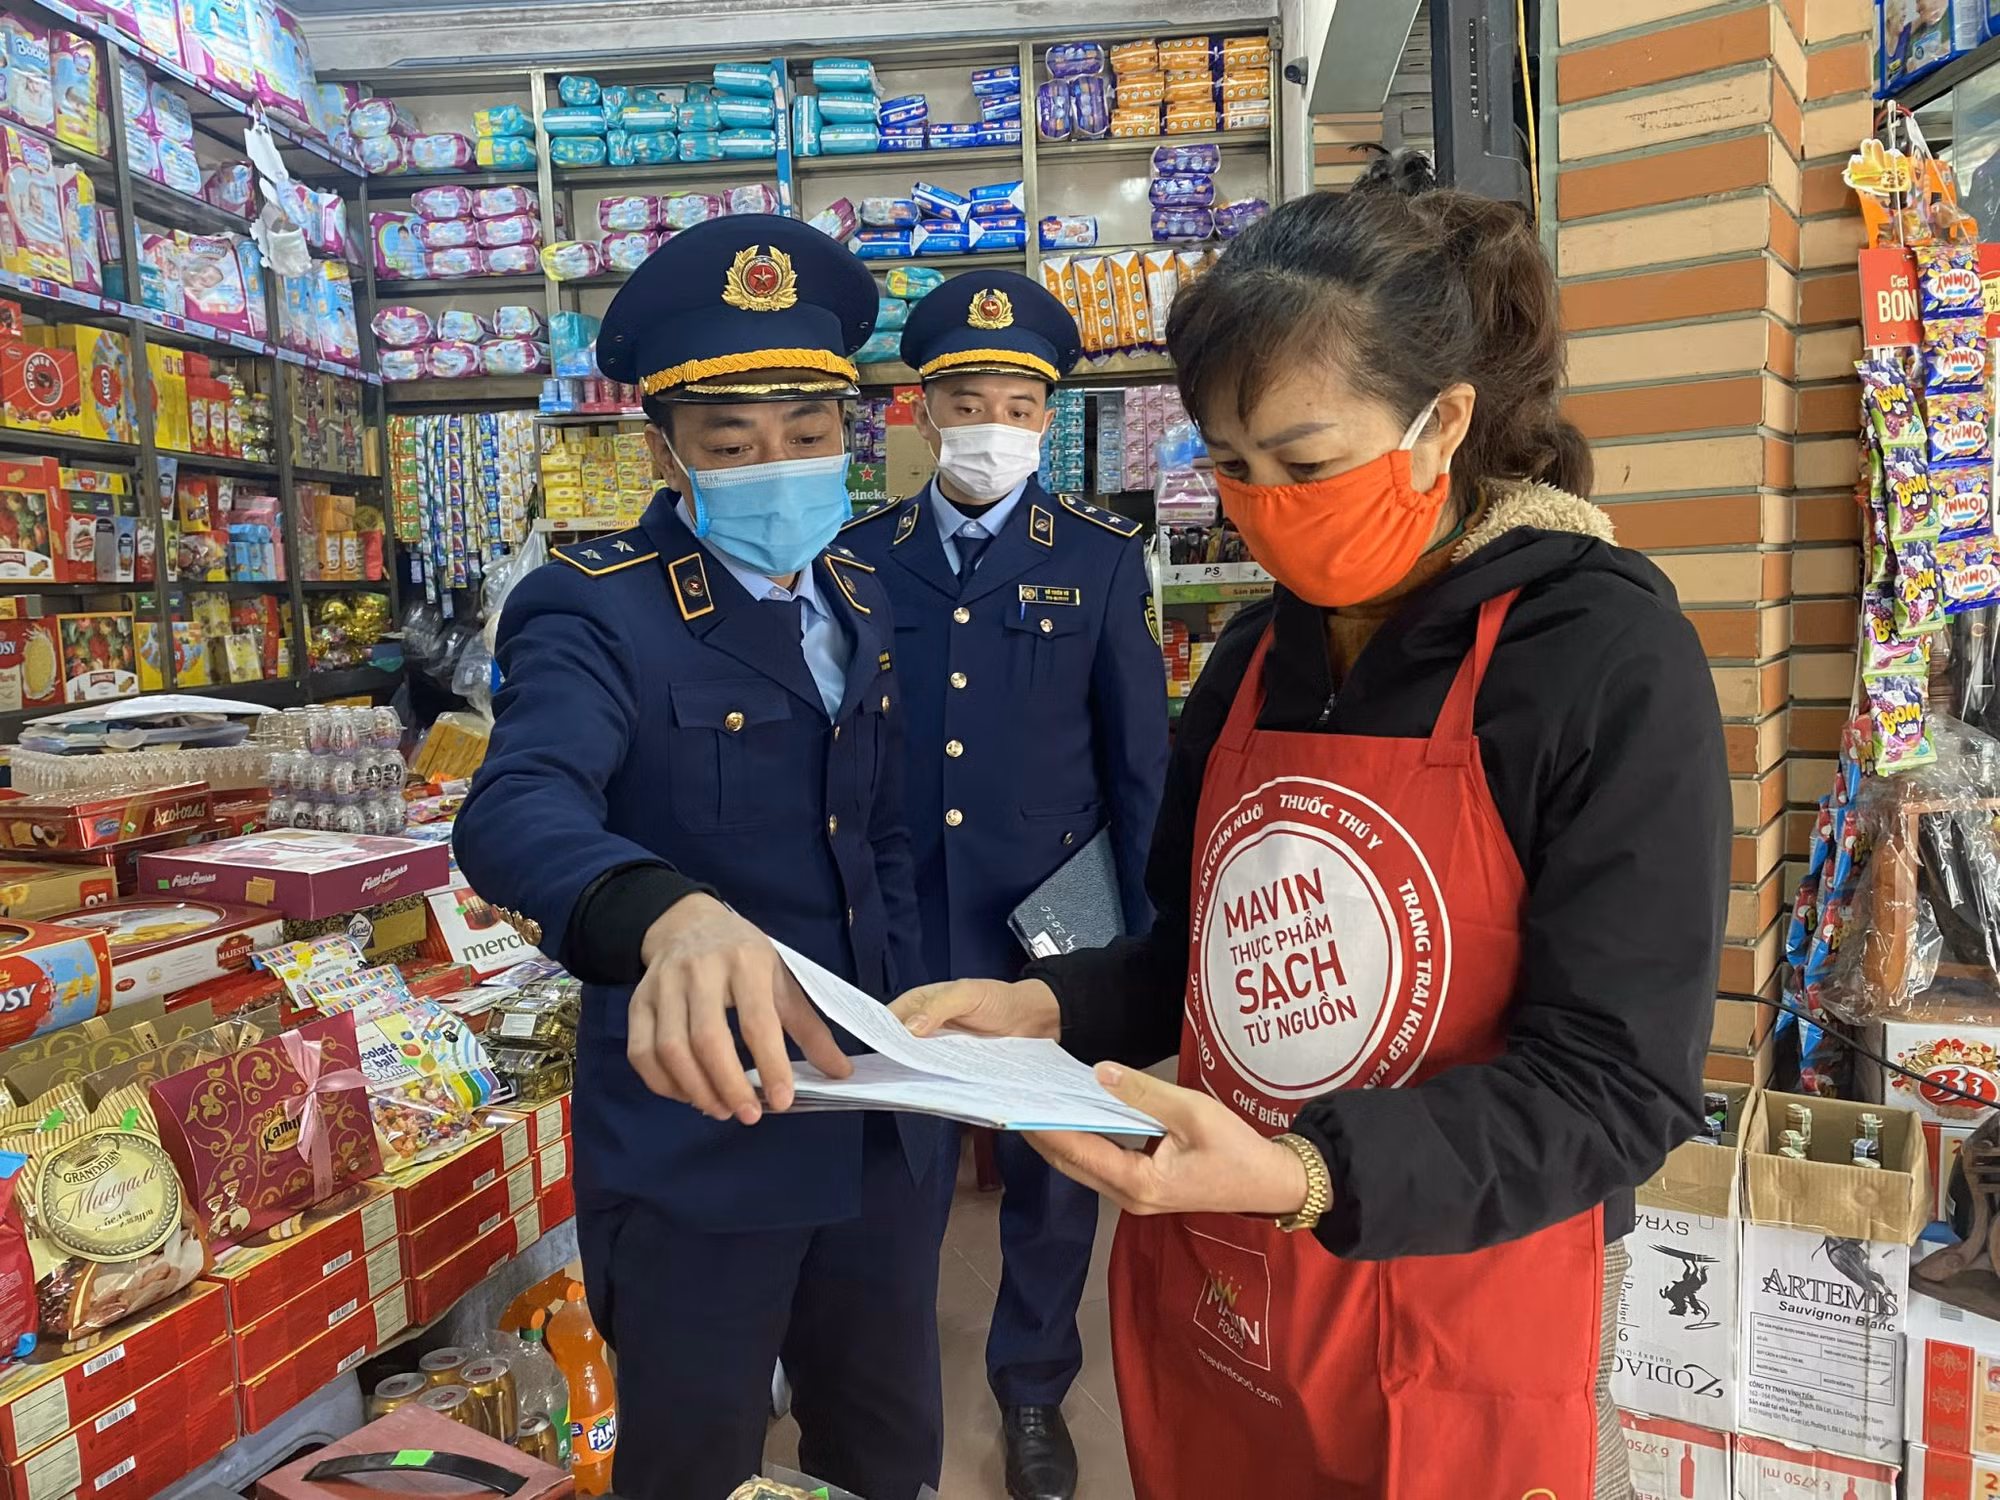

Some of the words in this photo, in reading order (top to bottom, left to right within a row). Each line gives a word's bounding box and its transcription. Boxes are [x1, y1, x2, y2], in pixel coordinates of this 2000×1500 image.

[777, 112, 788, 150] HUGGIES
[1936, 270, 1979, 293] TOMMY
[1877, 289, 1919, 323] BON
[1943, 350, 1982, 371] TOMMY
[1943, 424, 1986, 446] TOMMY
[848, 488, 889, 500] eineke
[1948, 496, 1987, 517] TOMMY
[1952, 567, 1998, 591] TOMMY
[1279, 793, 1335, 820] THUỐC
[1338, 807, 1372, 840] THÚ
[1366, 834, 1384, 851] Y
[1223, 867, 1326, 939] MAVIN
[1397, 878, 1432, 952] TRANG
[217, 944, 254, 961] MAJESTIC
[462, 933, 526, 963] merci
[1230, 935, 1274, 968] THỰC
[1276, 906, 1333, 951] PHẨM
[1235, 940, 1348, 1015] SẠCH
[1411, 957, 1433, 1004] TRẠI
[1243, 1016, 1272, 1048] TỪ
[1276, 989, 1359, 1040] NGUỒN
[1388, 1005, 1425, 1062] KHÉP
[373, 1054, 398, 1069] ball
[1929, 1066, 1984, 1102] 333
[1233, 1088, 1259, 1117] CHẾ
[1258, 1105, 1290, 1129] BIẾN
[1761, 1268, 1899, 1317] ARTEMIS
[1778, 1300, 1851, 1324] Sauvignon
[1855, 1317, 1896, 1332] Blanc
[1218, 1318, 1245, 1349] FOODS
[1198, 1348, 1284, 1409] mavinfood.com
[587, 1415, 615, 1450] FAN
[1660, 1446, 1670, 1458] 6
[1763, 1467, 1780, 1479] ml
[1784, 1472, 1819, 1489] x750
